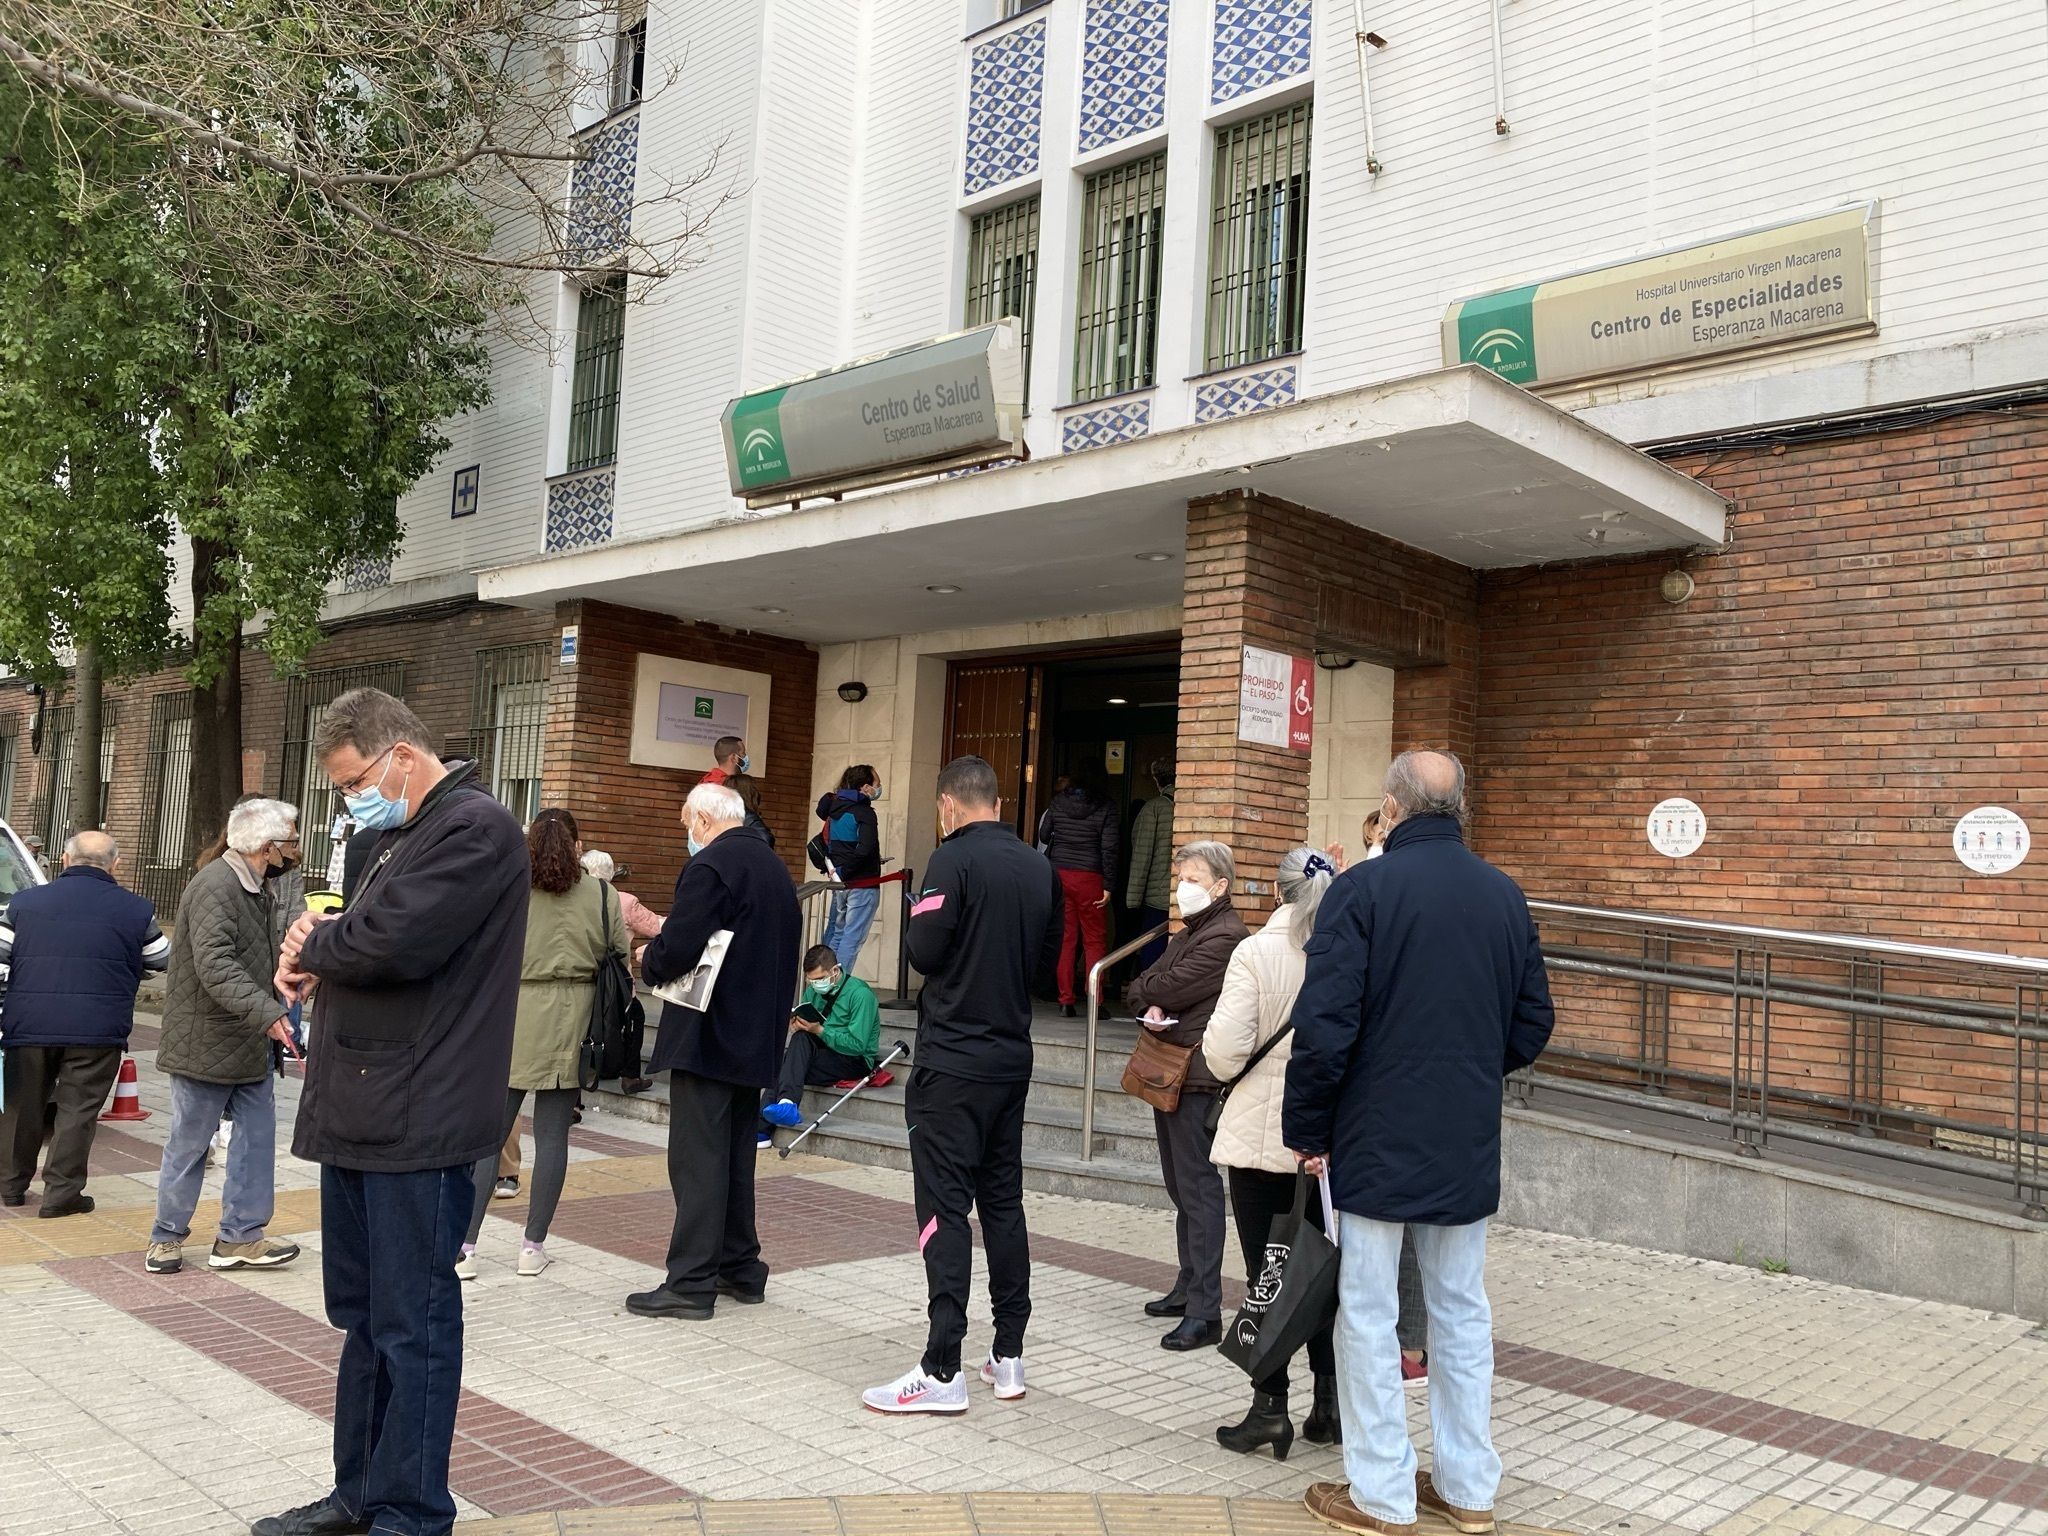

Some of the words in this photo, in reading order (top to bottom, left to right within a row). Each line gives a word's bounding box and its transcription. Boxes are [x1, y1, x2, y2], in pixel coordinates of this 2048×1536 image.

[1636, 281, 1677, 301] Hospital
[1680, 267, 1745, 292] Universitario
[1747, 261, 1781, 276] Virgen
[1785, 247, 1841, 269] Macarena
[1591, 316, 1651, 339] Centro
[1660, 306, 1681, 326] de
[1692, 275, 1843, 319] Especialidades
[1693, 317, 1765, 342] Esperanza
[1770, 302, 1844, 327] Macarena
[861, 397, 908, 426] Centro
[913, 389, 932, 414] de
[935, 375, 980, 409] Salud
[883, 422, 932, 444] Esperanza
[934, 410, 984, 432] Macarena
[1243, 674, 1285, 692] PROHIBIDO
[1250, 688, 1257, 697] EL
[1259, 690, 1276, 701] PASO
